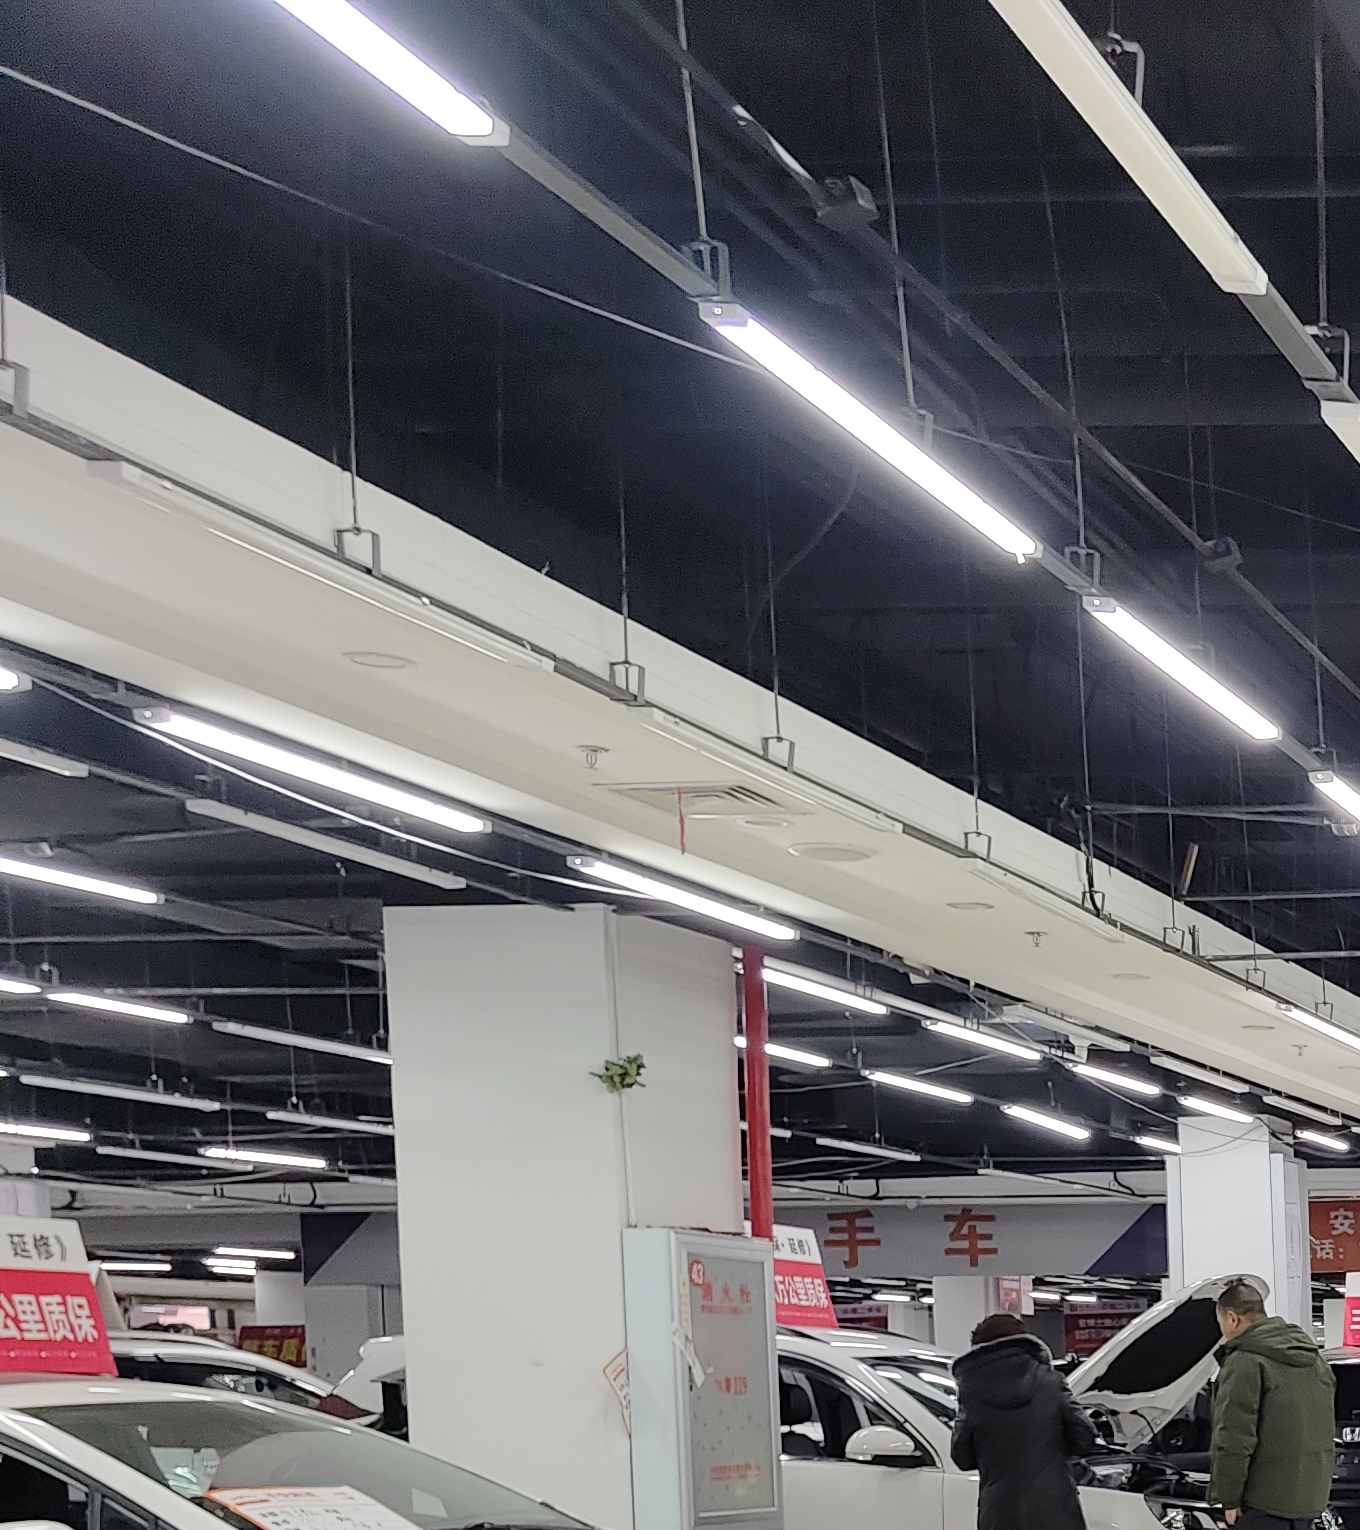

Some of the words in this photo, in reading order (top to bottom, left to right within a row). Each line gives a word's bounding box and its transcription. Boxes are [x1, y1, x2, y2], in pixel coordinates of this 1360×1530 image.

[690, 1262, 705, 1285] 43
[0, 1292, 99, 1343] 公里质保
